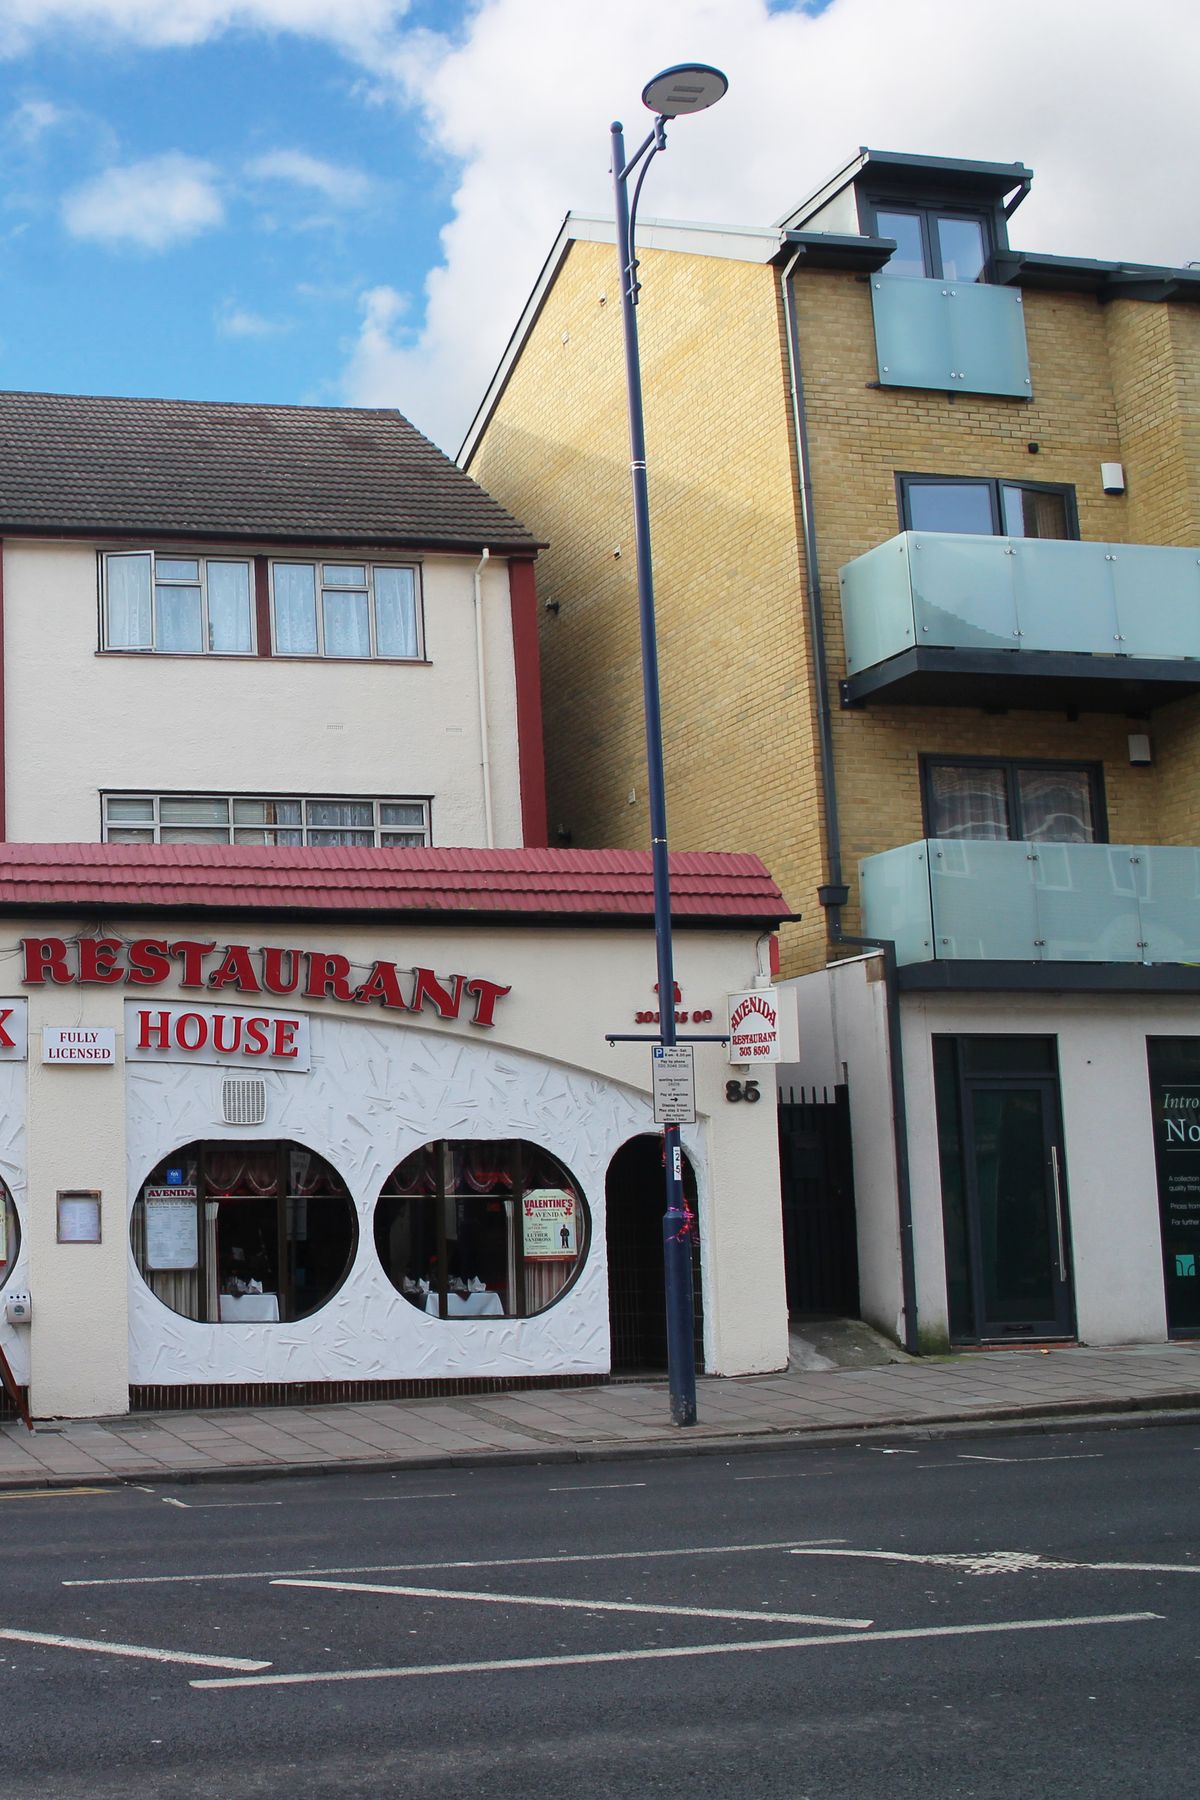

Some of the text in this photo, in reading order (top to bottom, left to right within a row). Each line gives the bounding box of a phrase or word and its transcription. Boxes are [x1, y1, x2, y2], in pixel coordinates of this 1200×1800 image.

[20, 936, 512, 1028] RESTAURANT
[731, 996, 777, 1033] AVENIDA
[60, 1032, 99, 1043] FULLY
[136, 1009, 300, 1058] HOUSE
[732, 1031, 777, 1045] RESTAURANT
[48, 1048, 111, 1059] LICENSED
[753, 1045, 770, 1055] 8500
[726, 1080, 761, 1103] 85
[524, 1199, 573, 1209] VALENTINE'S
